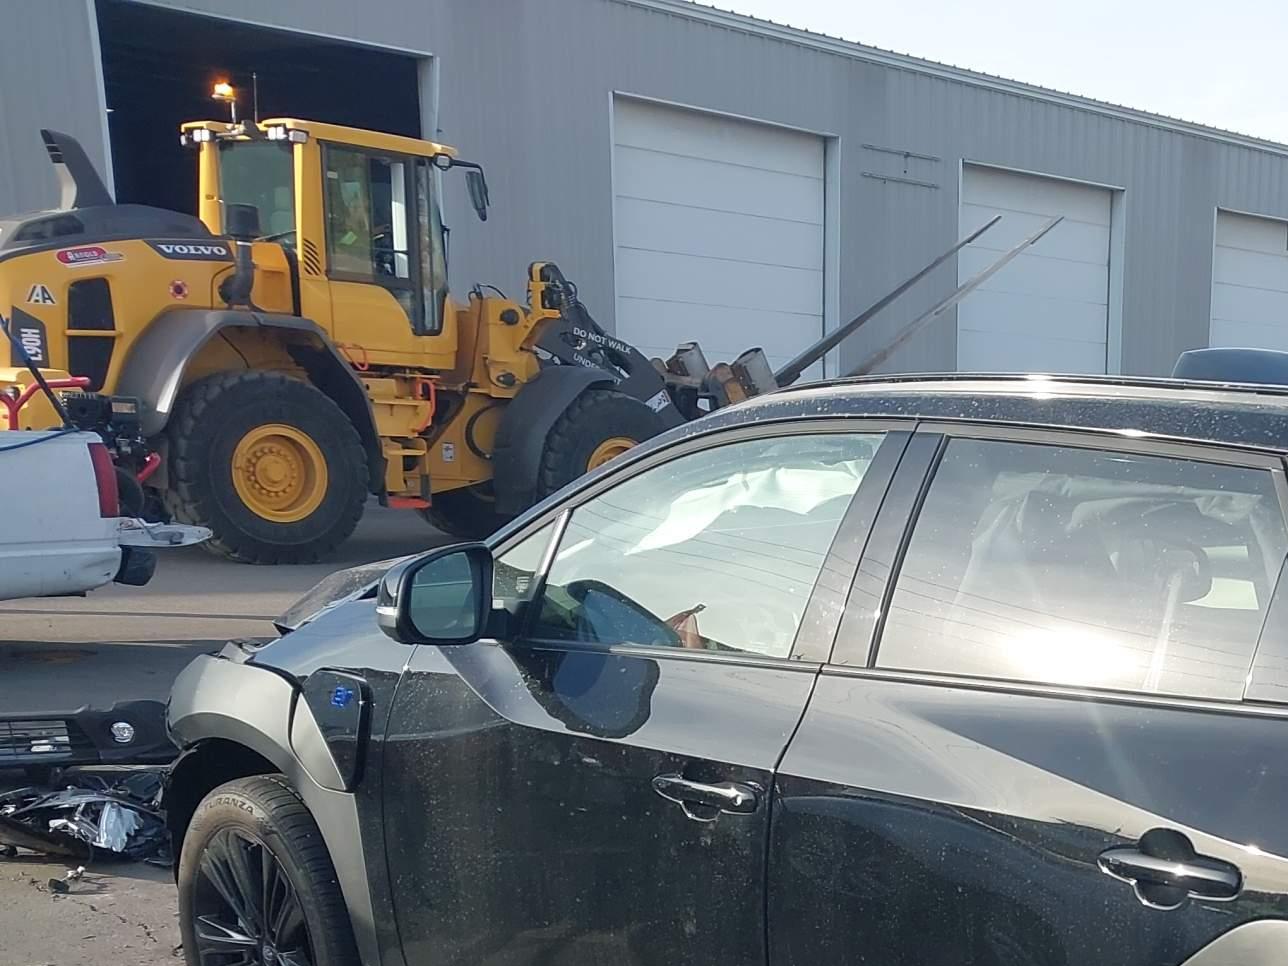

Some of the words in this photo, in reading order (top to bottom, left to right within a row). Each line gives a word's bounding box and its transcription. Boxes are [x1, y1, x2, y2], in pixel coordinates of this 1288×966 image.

[157, 244, 227, 256] VOLVO
[573, 327, 587, 338] DO
[588, 332, 607, 345] NOT
[608, 339, 631, 355] WALK
